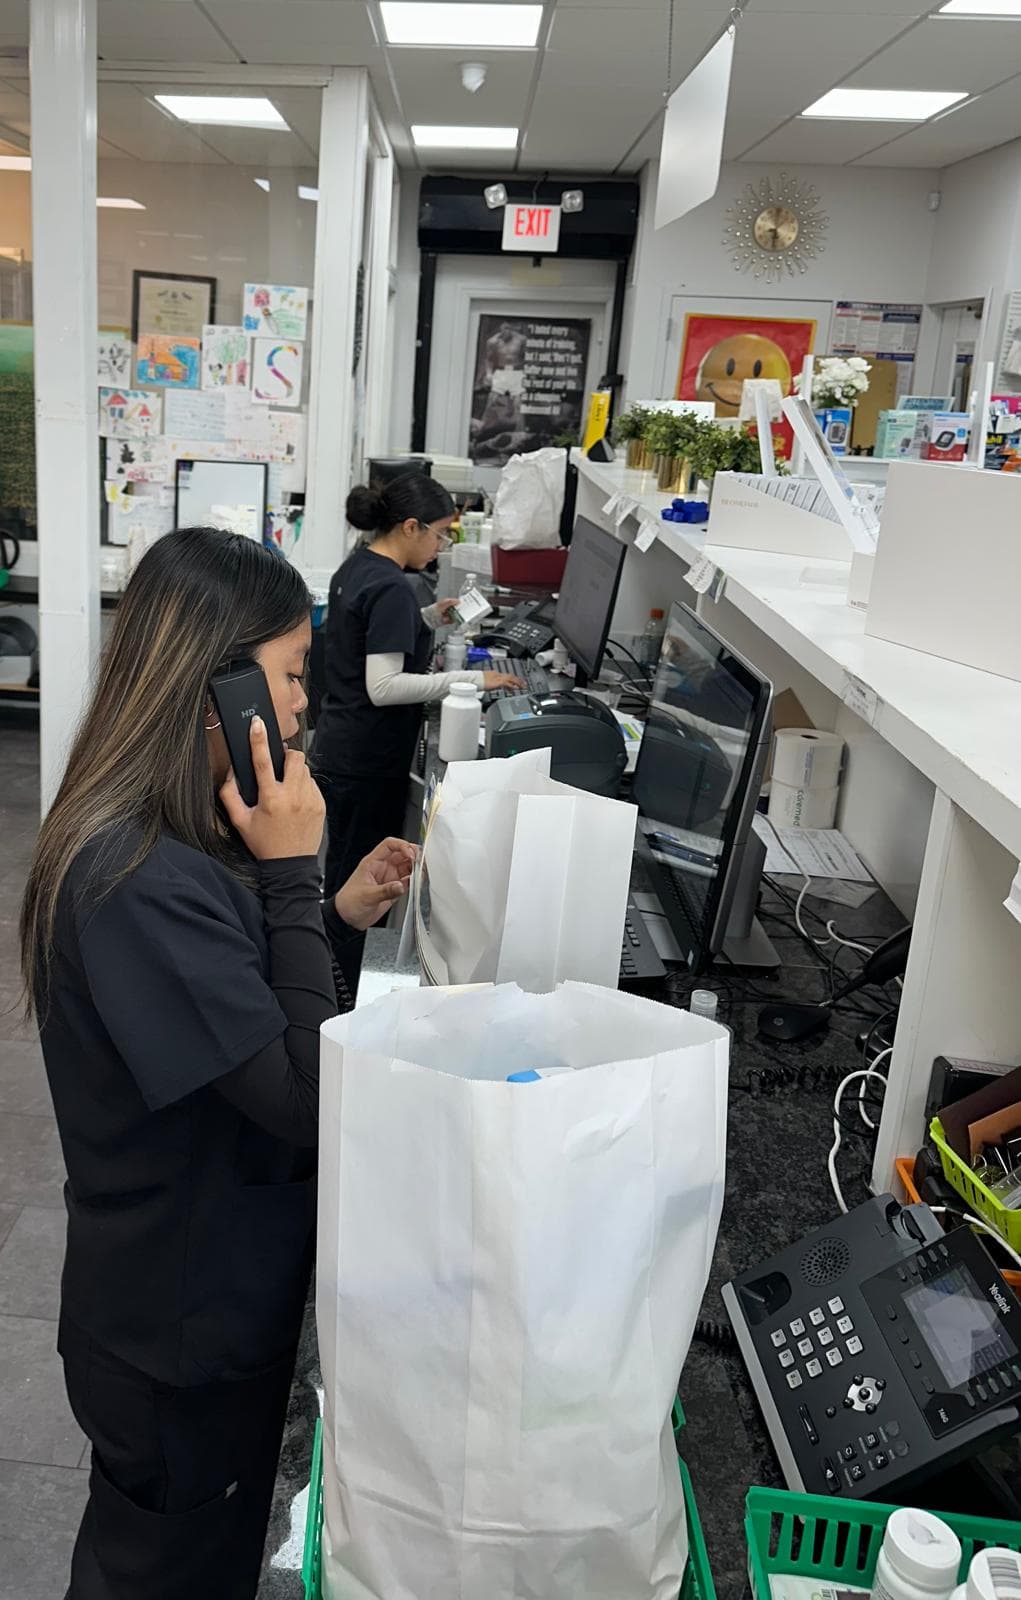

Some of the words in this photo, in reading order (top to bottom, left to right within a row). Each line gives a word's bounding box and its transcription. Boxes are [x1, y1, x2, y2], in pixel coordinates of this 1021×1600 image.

[514, 207, 553, 238] EXIT
[241, 708, 256, 719] HD
[989, 1283, 1011, 1314] Yealink
